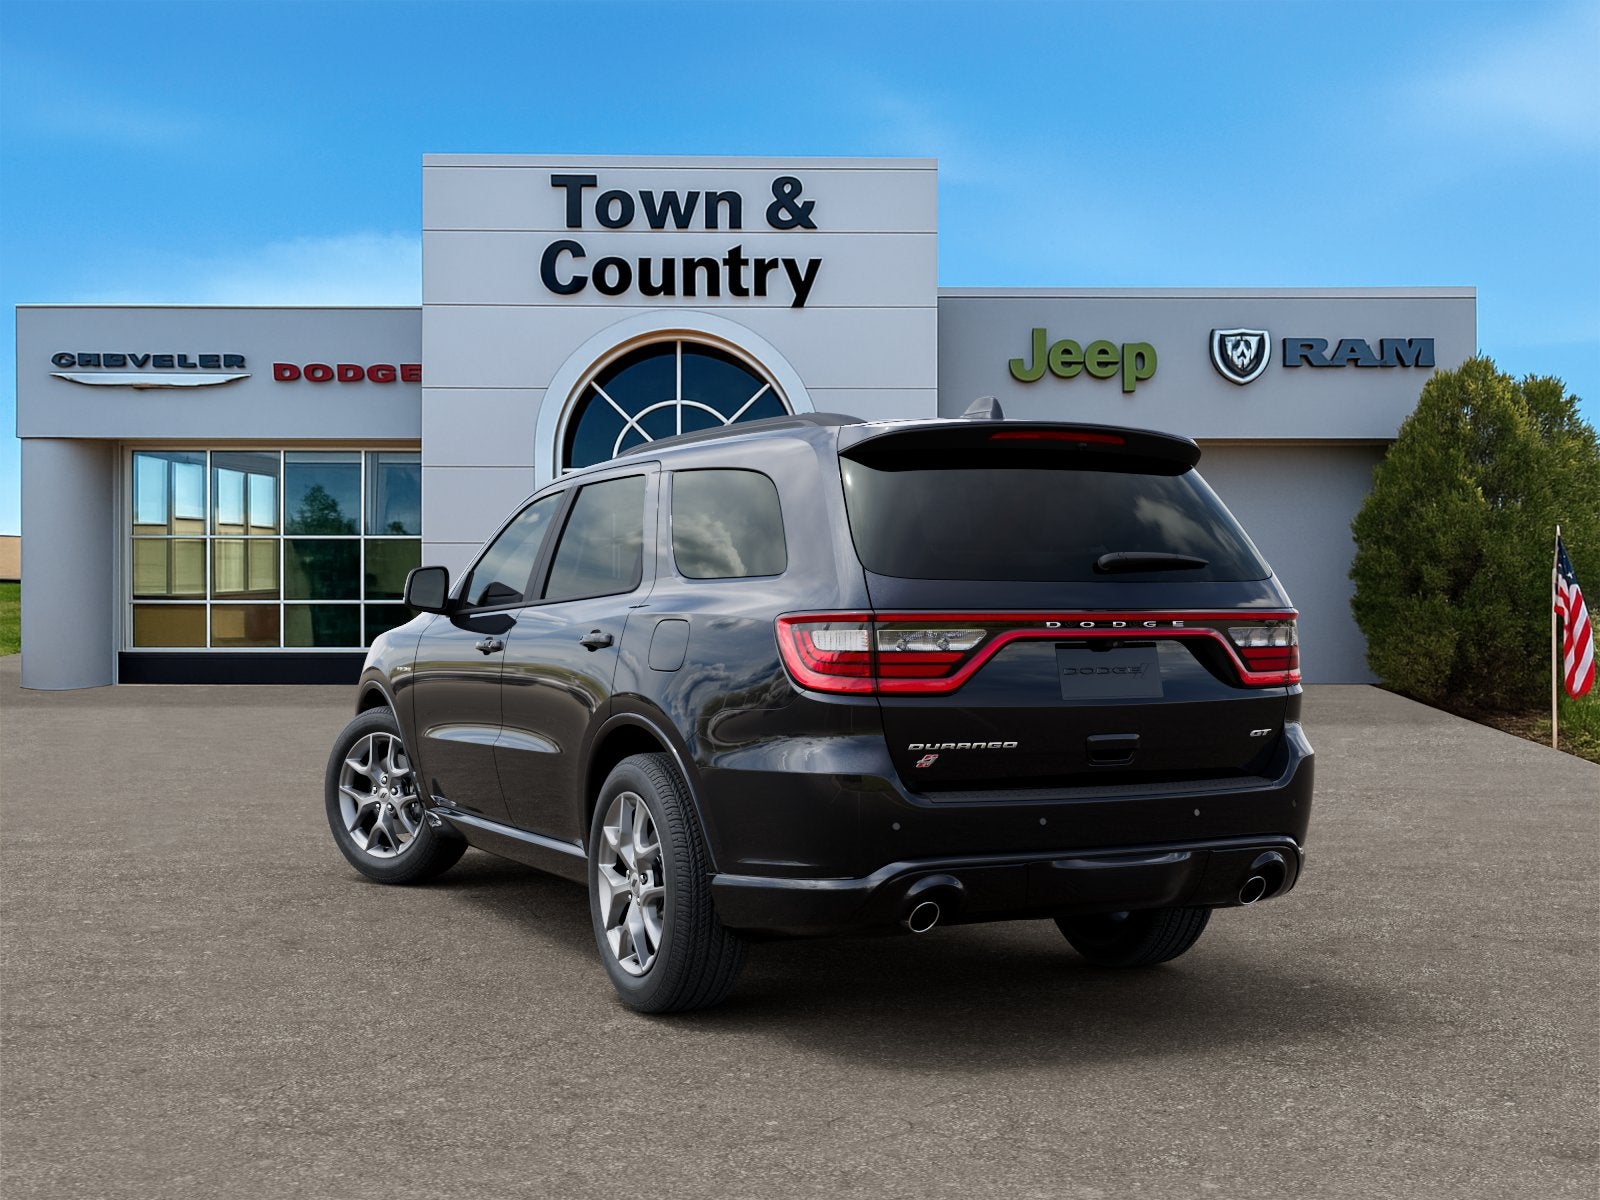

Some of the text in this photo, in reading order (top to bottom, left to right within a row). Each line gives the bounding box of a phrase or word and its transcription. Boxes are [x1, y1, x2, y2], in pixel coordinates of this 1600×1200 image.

[550, 174, 818, 231] Town &
[540, 239, 823, 308] Country
[1008, 327, 1158, 393] Jeep
[1282, 337, 1436, 368] RAM
[273, 362, 422, 383] DODGE
[1046, 620, 1185, 628] DODGE
[1063, 666, 1143, 676] DODGE
[1250, 728, 1272, 737] GT
[907, 741, 1018, 751] DURANGO
